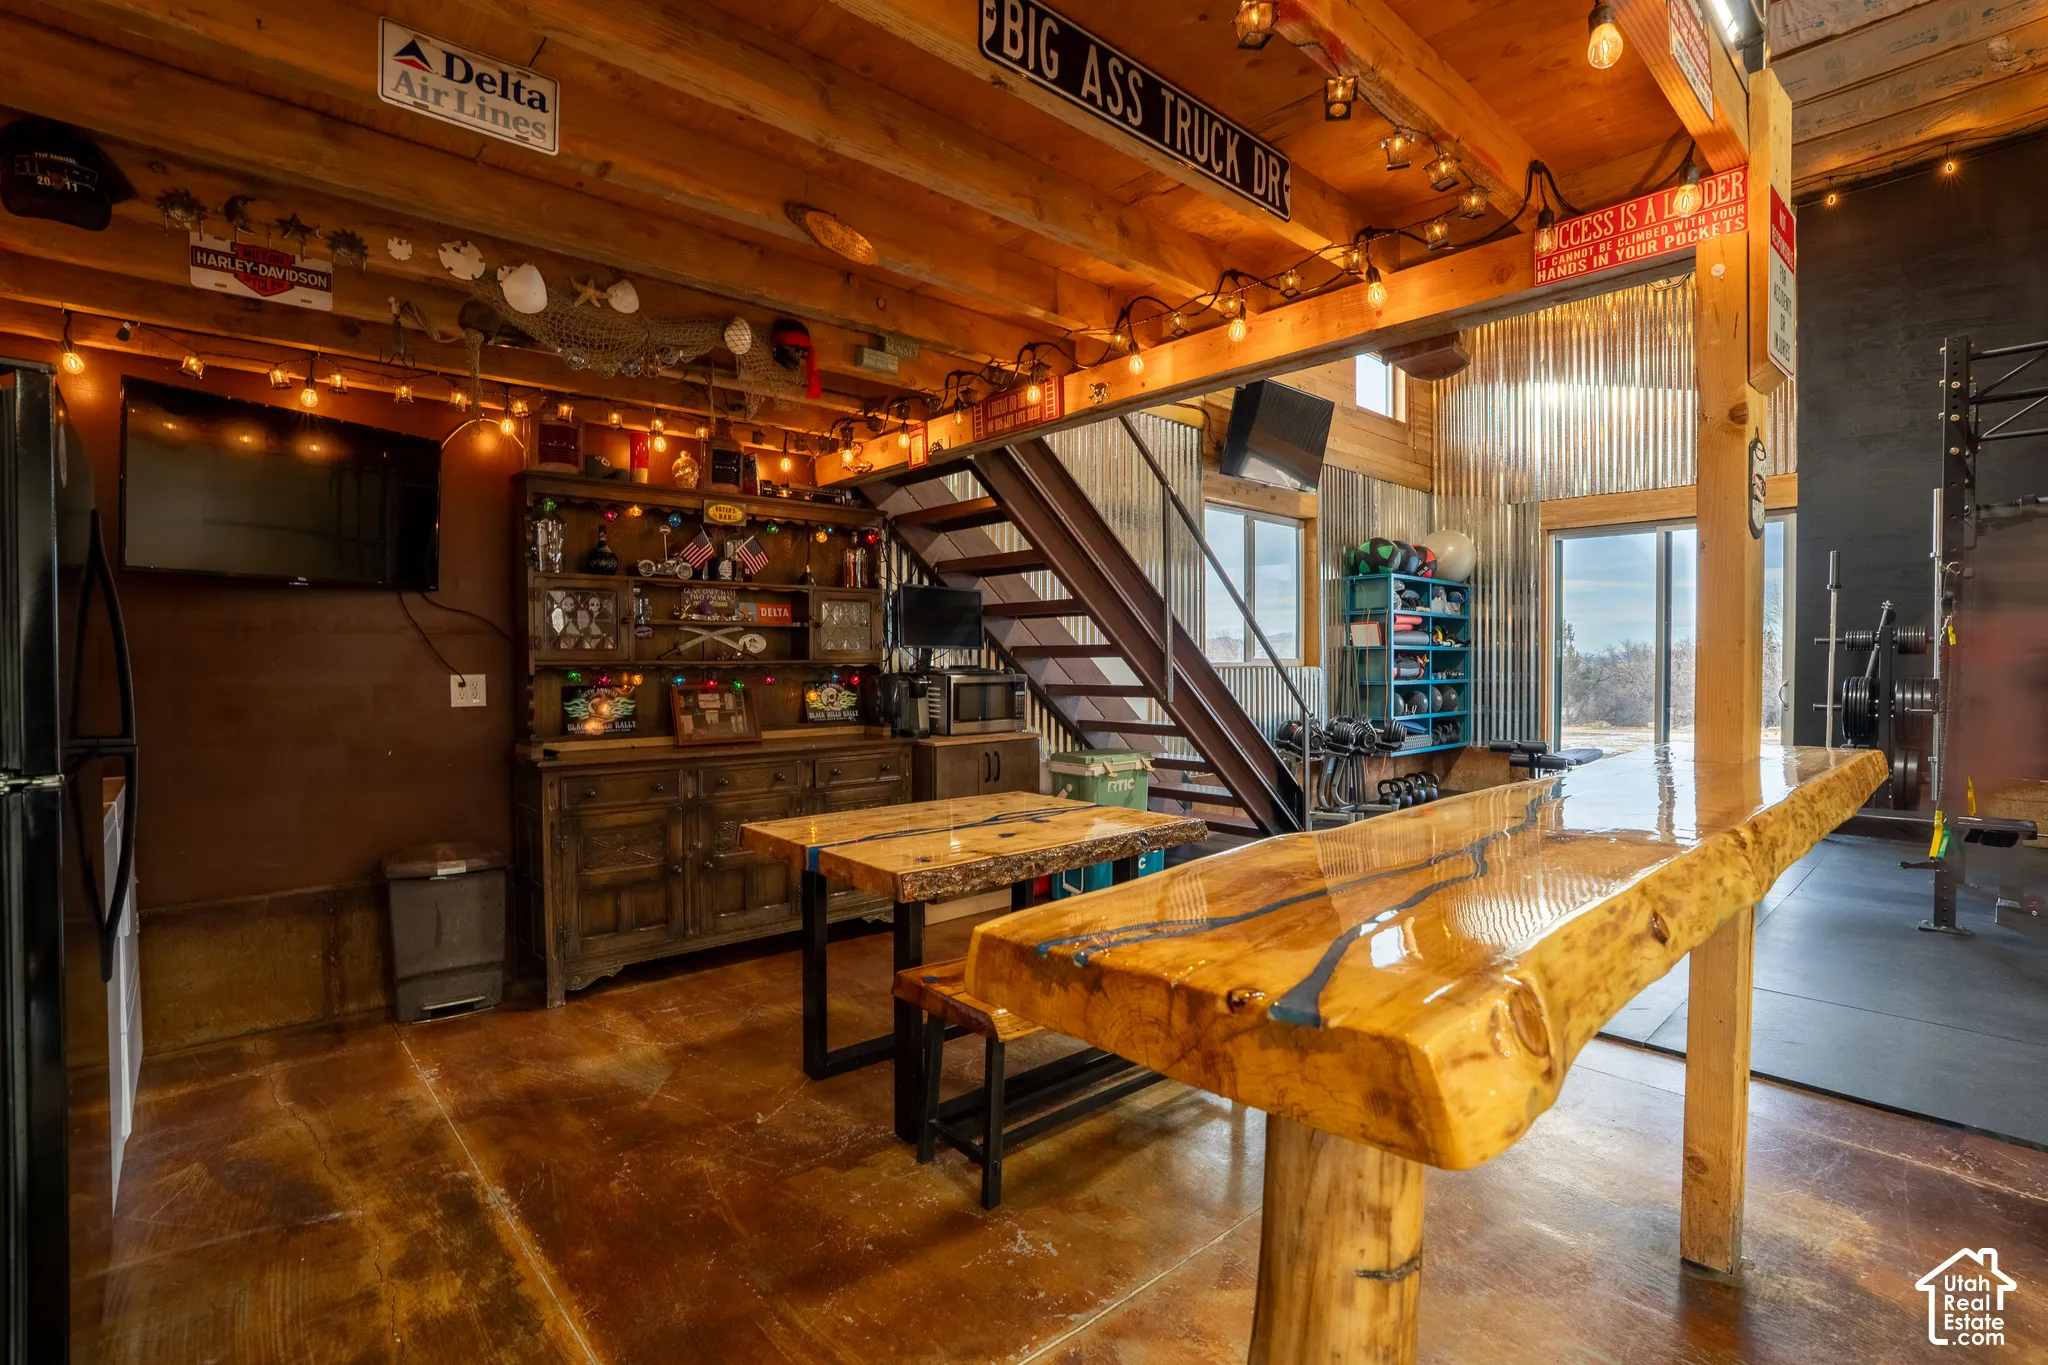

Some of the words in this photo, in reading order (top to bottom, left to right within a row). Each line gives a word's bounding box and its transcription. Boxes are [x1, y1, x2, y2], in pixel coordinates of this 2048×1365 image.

[441, 50, 549, 113] Delta
[1003, 0, 1059, 81] BIG
[1081, 44, 1143, 126] ASS
[1161, 87, 1240, 184] TRUCK
[1254, 146, 1280, 207] DR
[1540, 208, 1614, 251] UCCESS
[1620, 202, 1638, 232] IS
[1644, 196, 1656, 226] A
[1664, 171, 1745, 219] LDER
[1537, 258, 1546, 270] IT
[1551, 246, 1593, 266] CANNOT
[1600, 239, 1613, 252] BE
[1617, 223, 1667, 248] CLIMBED
[1674, 213, 1706, 231] WITH
[1711, 204, 1745, 222] YOUR
[1537, 259, 1587, 283] HANDS
[1593, 252, 1609, 268] IN
[1615, 240, 1658, 262] YOUR
[1665, 216, 1746, 249] POCKETS
[196, 250, 328, 288] HARLEY-DAVIDSON
[885, 343, 920, 358] SUNSET
[760, 607, 790, 618] DELTA
[614, 720, 637, 730] RALLY
[1107, 778, 1135, 793] RTIC
